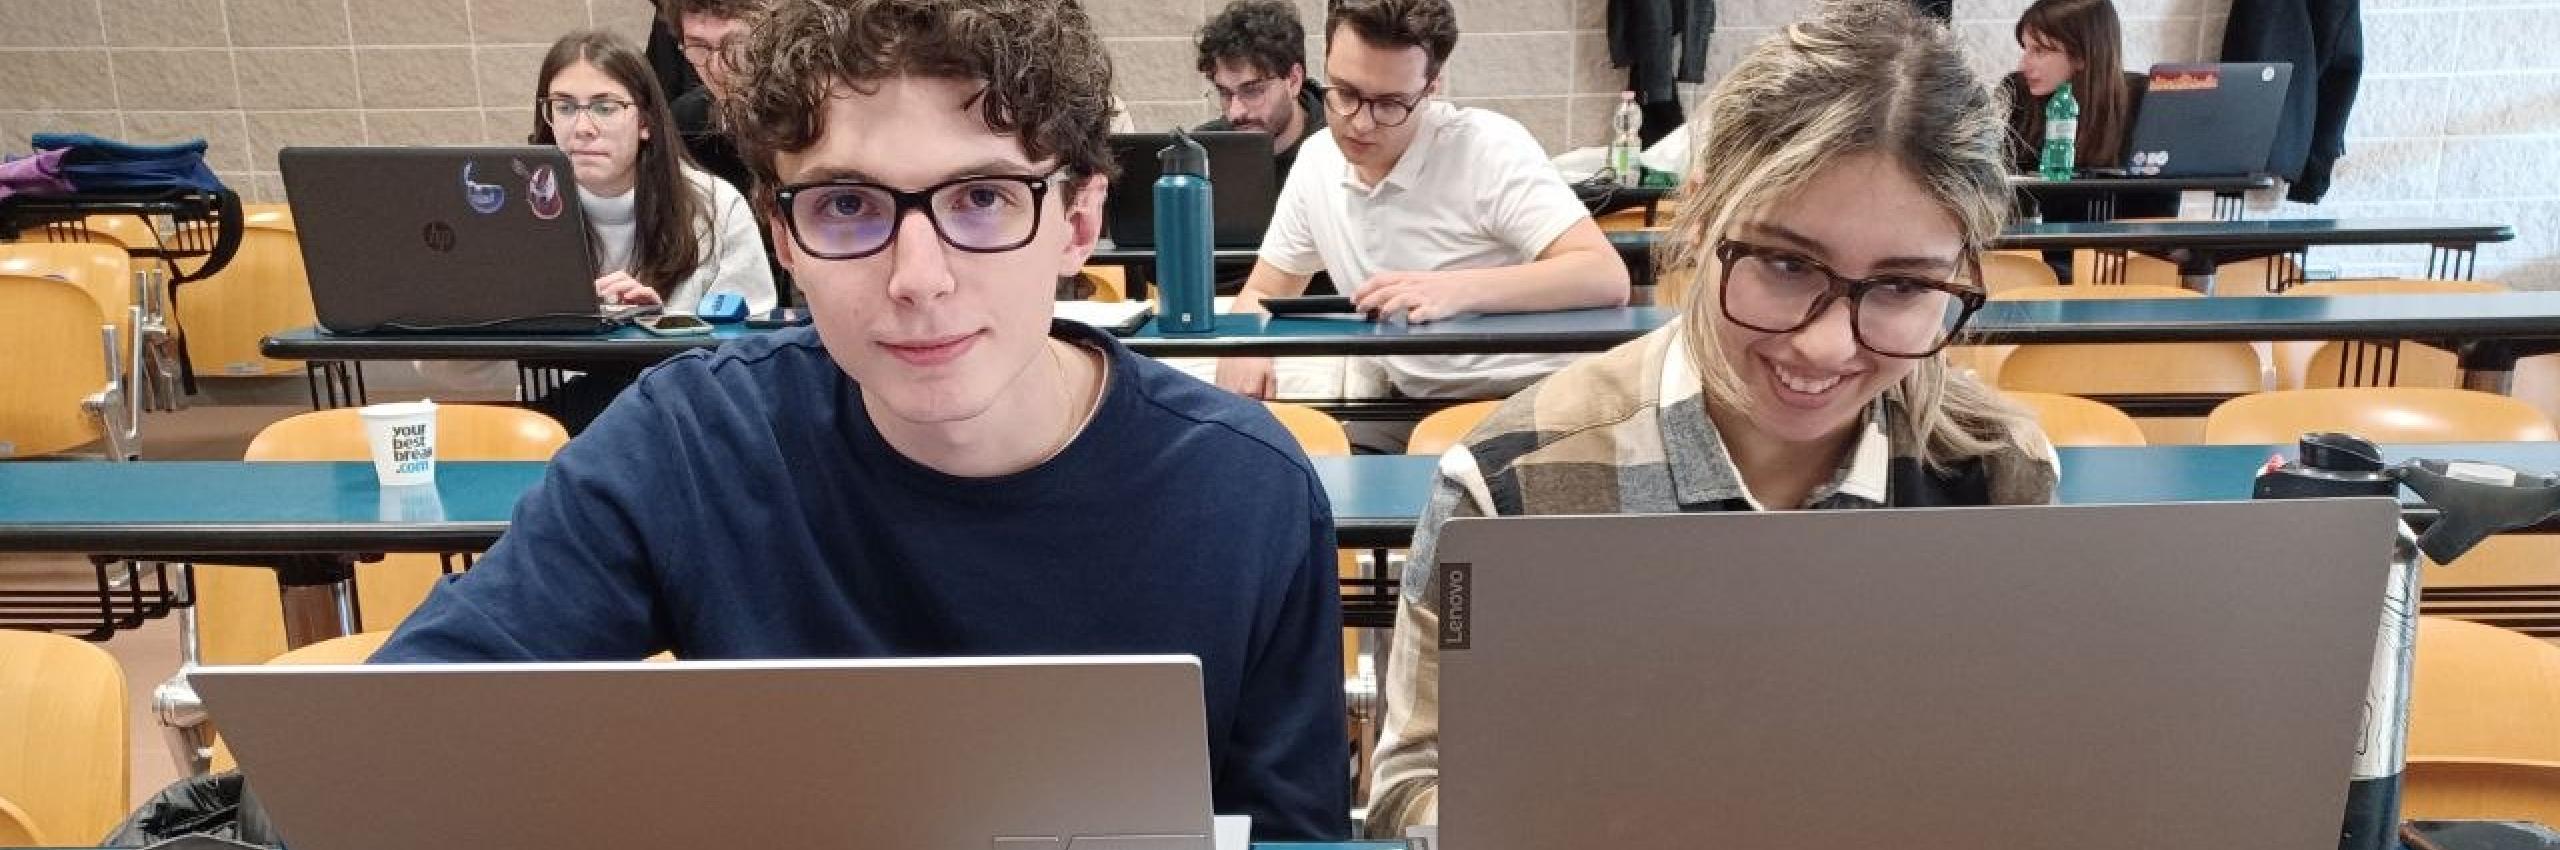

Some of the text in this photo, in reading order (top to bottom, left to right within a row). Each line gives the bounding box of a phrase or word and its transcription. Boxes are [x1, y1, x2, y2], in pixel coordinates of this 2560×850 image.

[428, 222, 453, 250] hp
[392, 424, 426, 437] your
[393, 436, 425, 450] best
[1446, 570, 1463, 643] Lenovo
